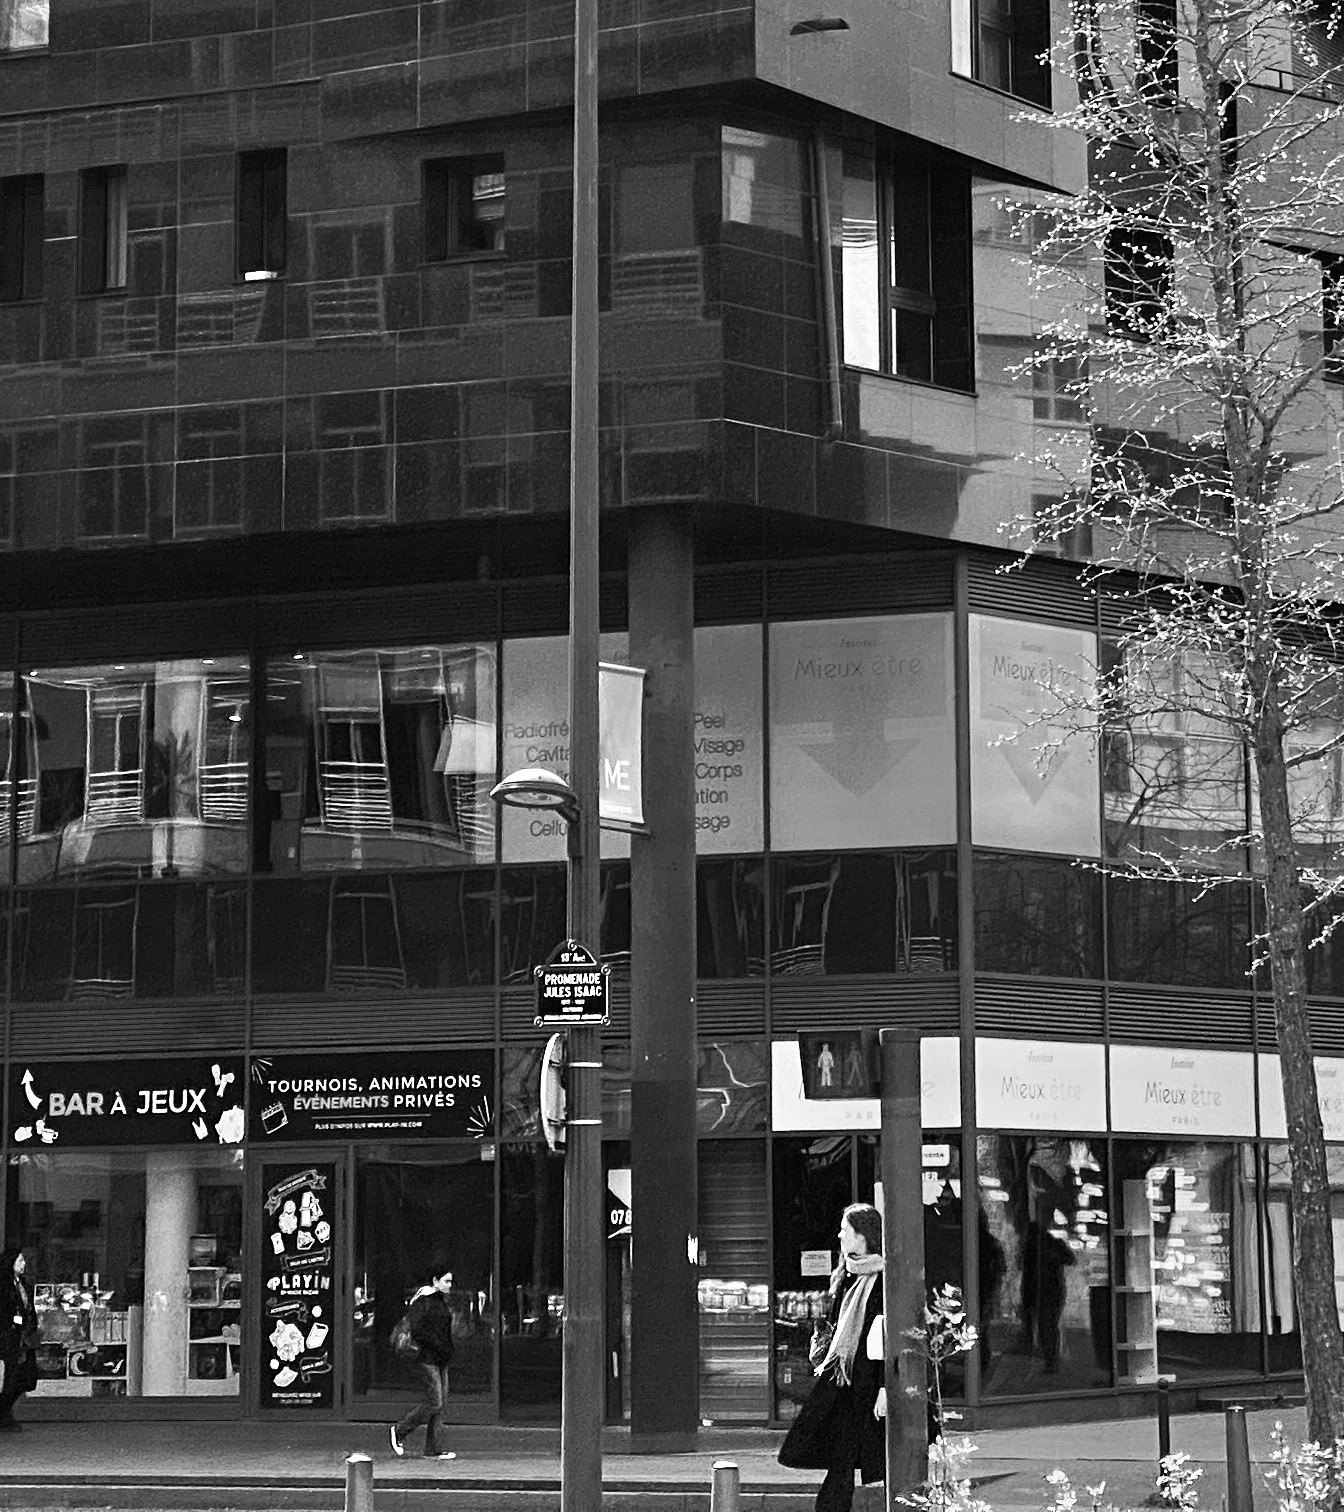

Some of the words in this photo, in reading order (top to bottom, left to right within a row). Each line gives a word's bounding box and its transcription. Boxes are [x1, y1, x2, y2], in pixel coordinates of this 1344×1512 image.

[795, 657, 862, 680] Mieux
[992, 655, 1036, 682] Mieux
[504, 719, 569, 739] Radiofré
[695, 762, 743, 782] Corps
[529, 819, 568, 837] Cellu
[544, 973, 601, 986] PROMENADE
[543, 986, 572, 998] JULES
[574, 985, 603, 997] ISAAC
[268, 1078, 363, 1094] TOURNOIS,
[368, 1073, 482, 1091] ANIMATIONS
[1000, 1075, 1045, 1099] Mieux
[1145, 1081, 1186, 1105] Mieux
[48, 1092, 105, 1117] BAR
[109, 1090, 127, 1115] À
[136, 1088, 207, 1114] JEUX
[393, 1090, 456, 1108] PRIVÉS
